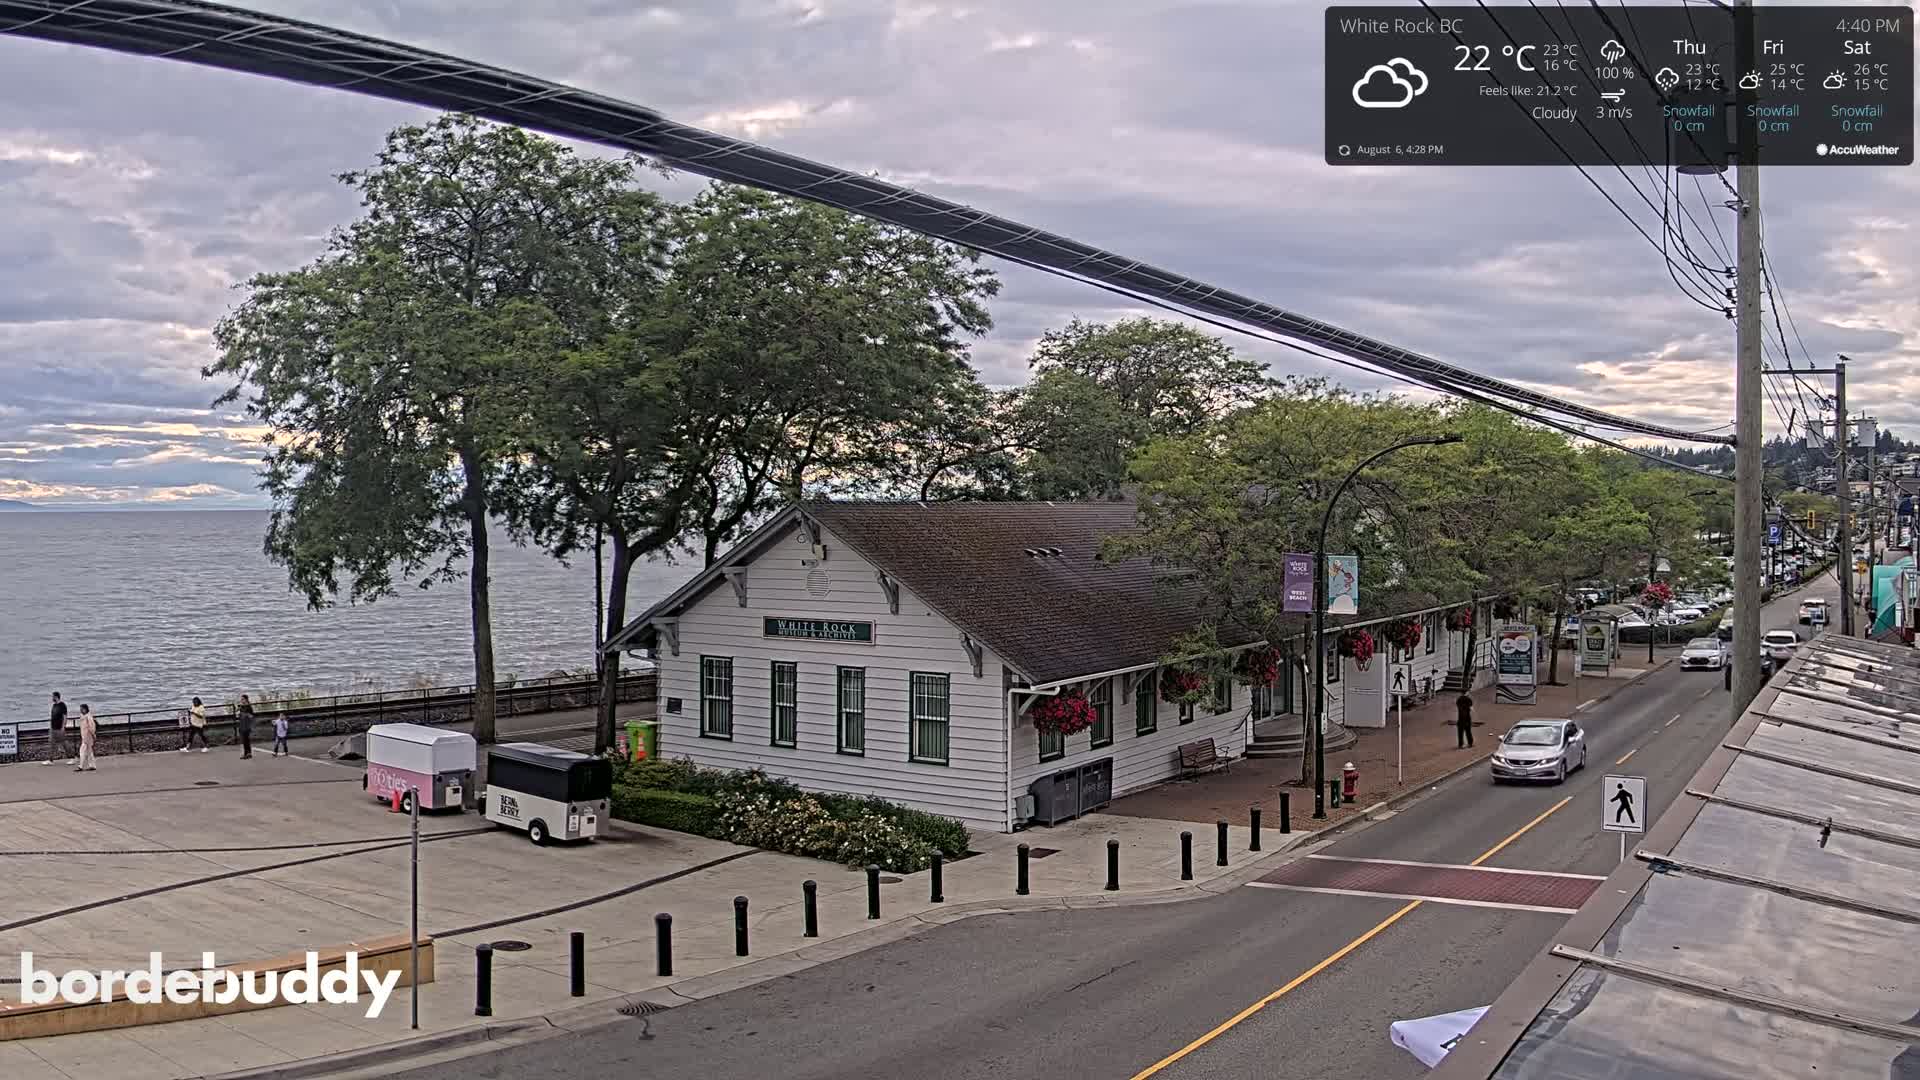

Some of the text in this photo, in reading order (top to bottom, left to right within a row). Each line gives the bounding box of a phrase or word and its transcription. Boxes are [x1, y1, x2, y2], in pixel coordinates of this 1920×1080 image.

[777, 620, 856, 633] WHITE ROCK
[778, 629, 808, 637] MUSEUM
[819, 631, 856, 640] ARCHIVES
[500, 804, 520, 818] BERRY
